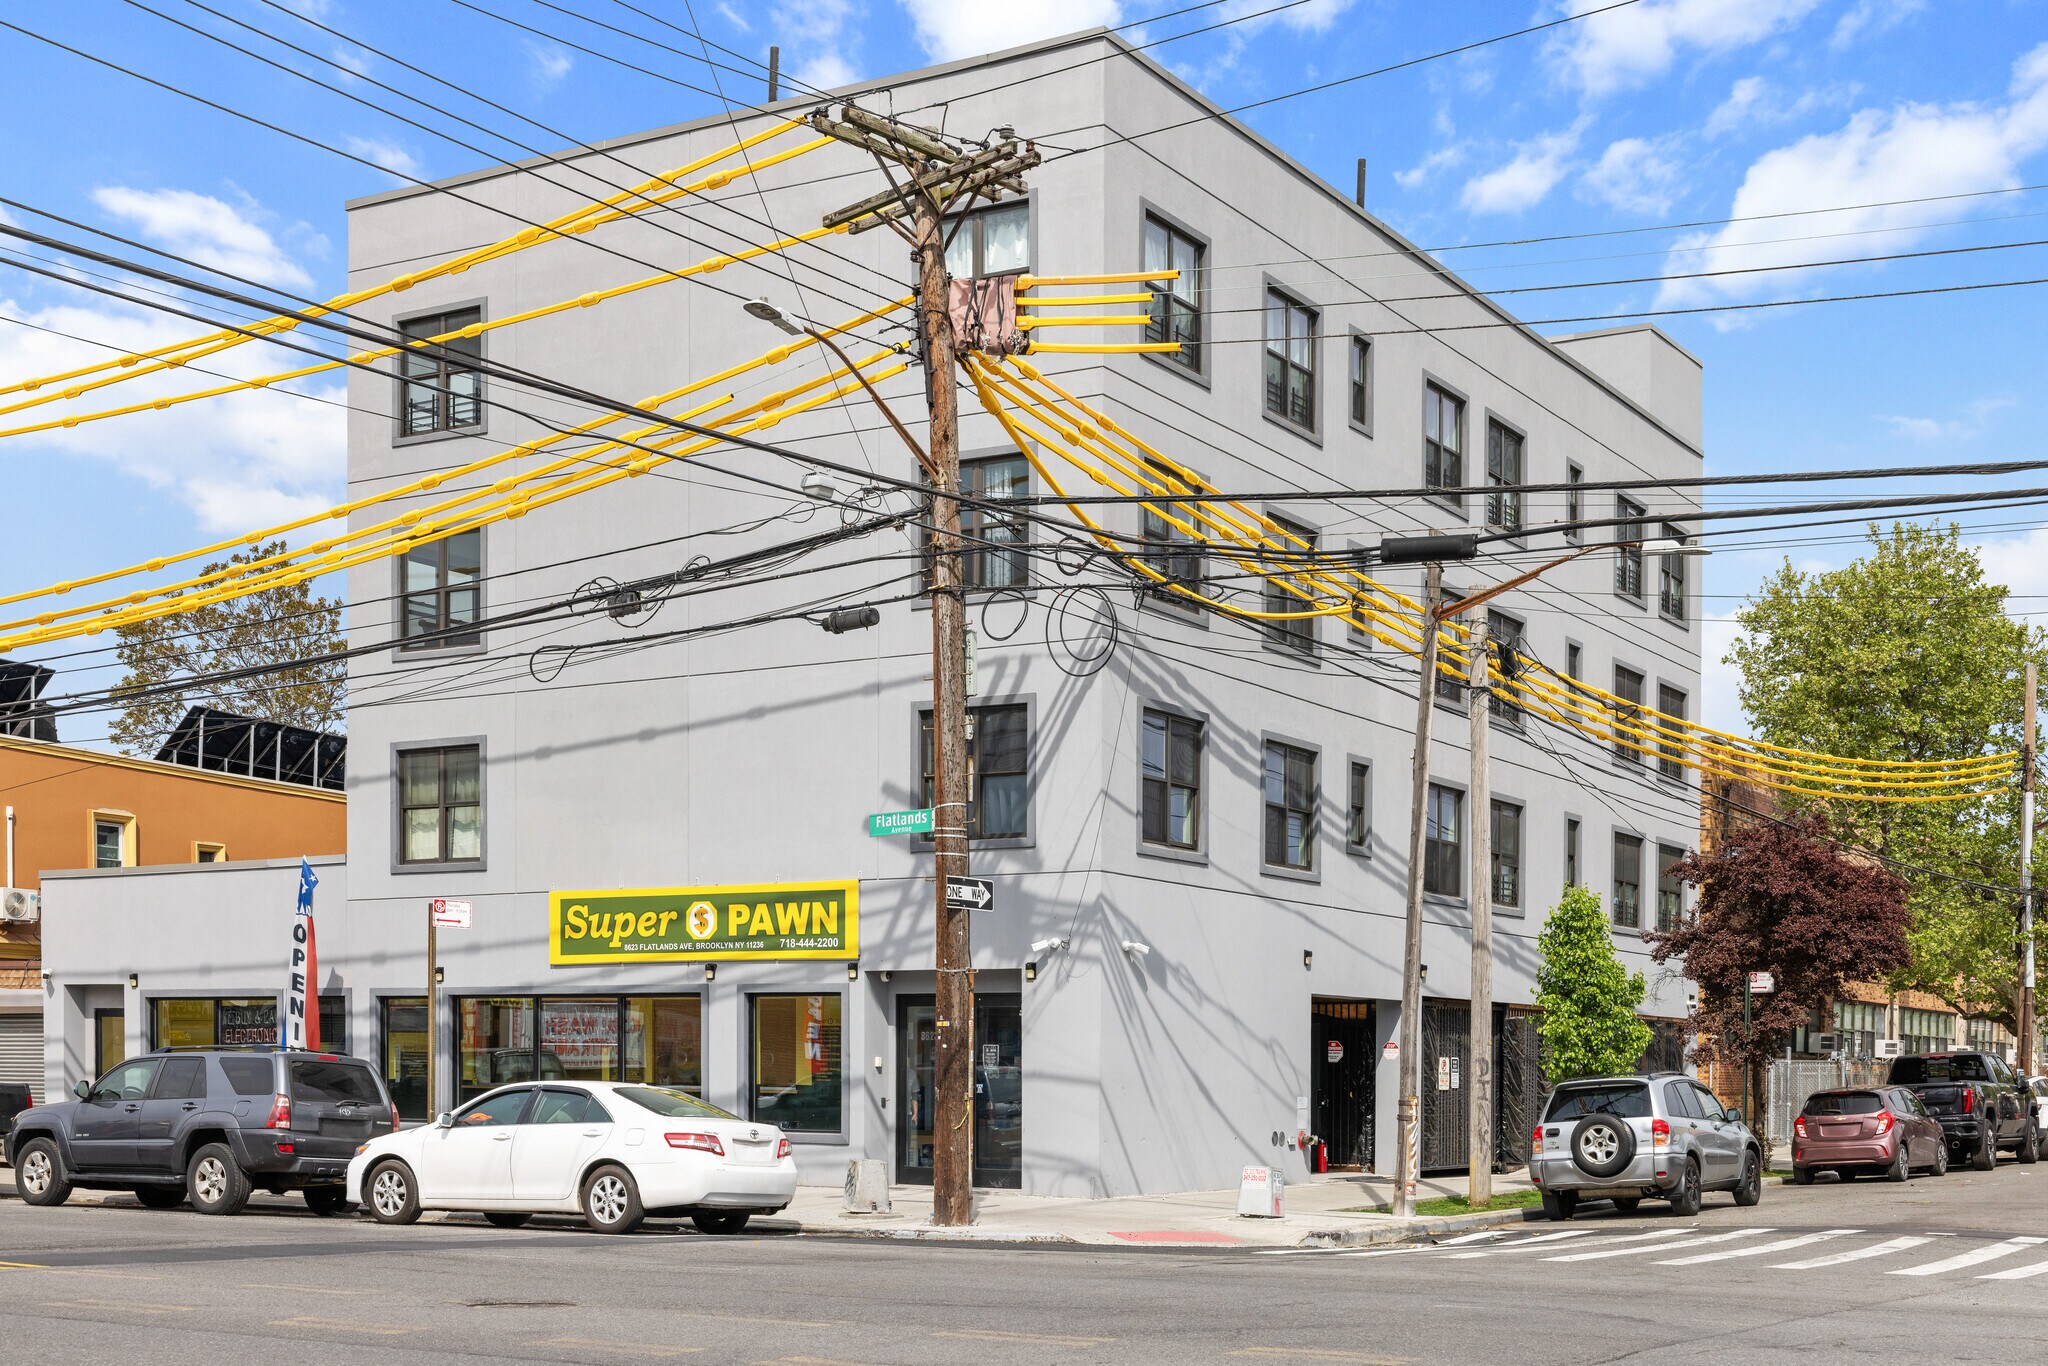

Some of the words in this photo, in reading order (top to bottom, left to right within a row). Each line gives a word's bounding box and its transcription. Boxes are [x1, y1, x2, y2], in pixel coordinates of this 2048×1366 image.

[876, 811, 927, 828] Flatlands
[891, 826, 912, 834] Avenue
[946, 885, 963, 899] ONE
[971, 888, 986, 901] WAY
[565, 905, 678, 947] Super
[728, 901, 838, 936] PAWN
[624, 943, 639, 951] 8623
[639, 942, 679, 951] FLATLANDS
[679, 942, 695, 950] AVE,
[695, 941, 734, 950] BROOKLYN
[735, 941, 745, 949] NY
[746, 940, 764, 949] 11236
[780, 937, 838, 948] 718-444-2200
[290, 923, 307, 1052] OPENI
[920, 1031, 936, 1041] 862
